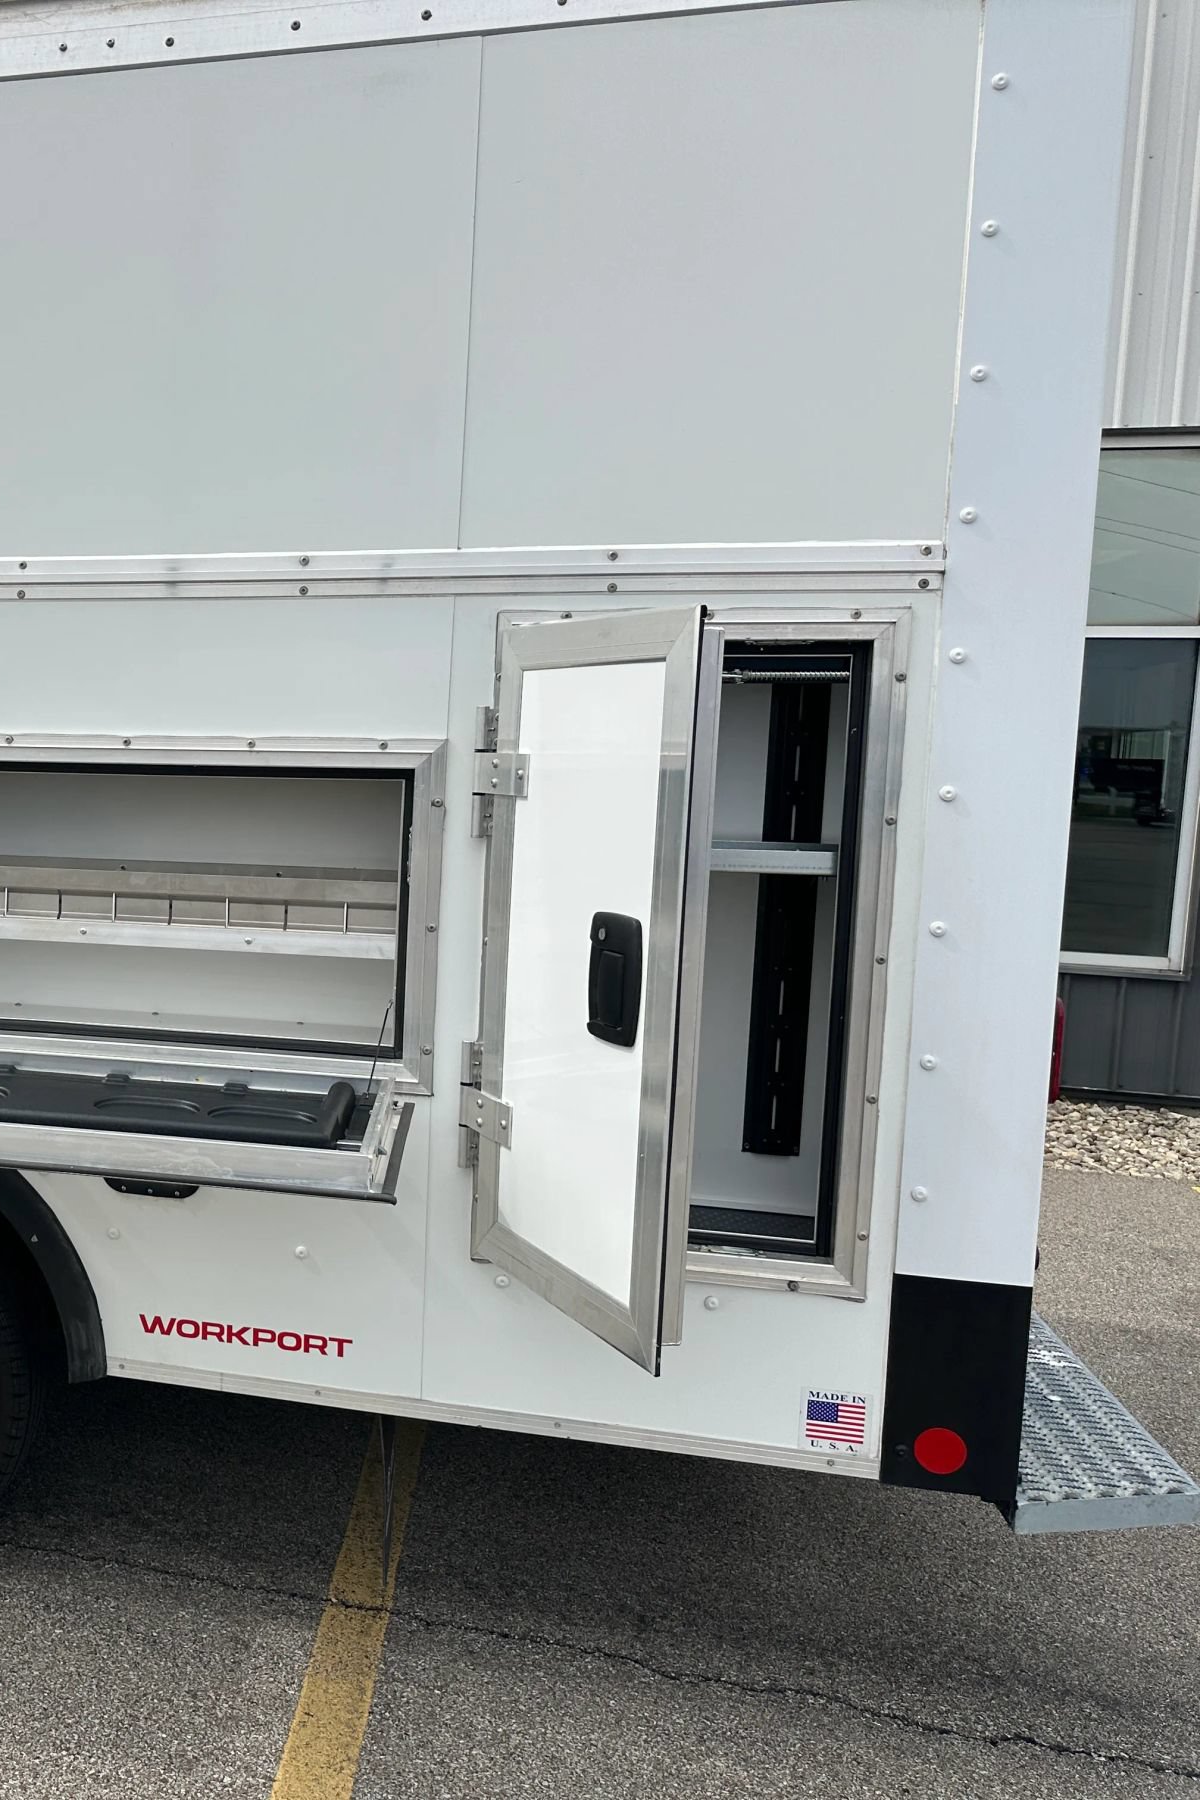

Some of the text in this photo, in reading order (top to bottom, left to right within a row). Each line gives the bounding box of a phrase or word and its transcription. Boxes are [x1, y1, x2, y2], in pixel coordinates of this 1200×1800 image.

[138, 1313, 354, 1358] WORKPORT
[808, 1391, 866, 1404] MADE IN
